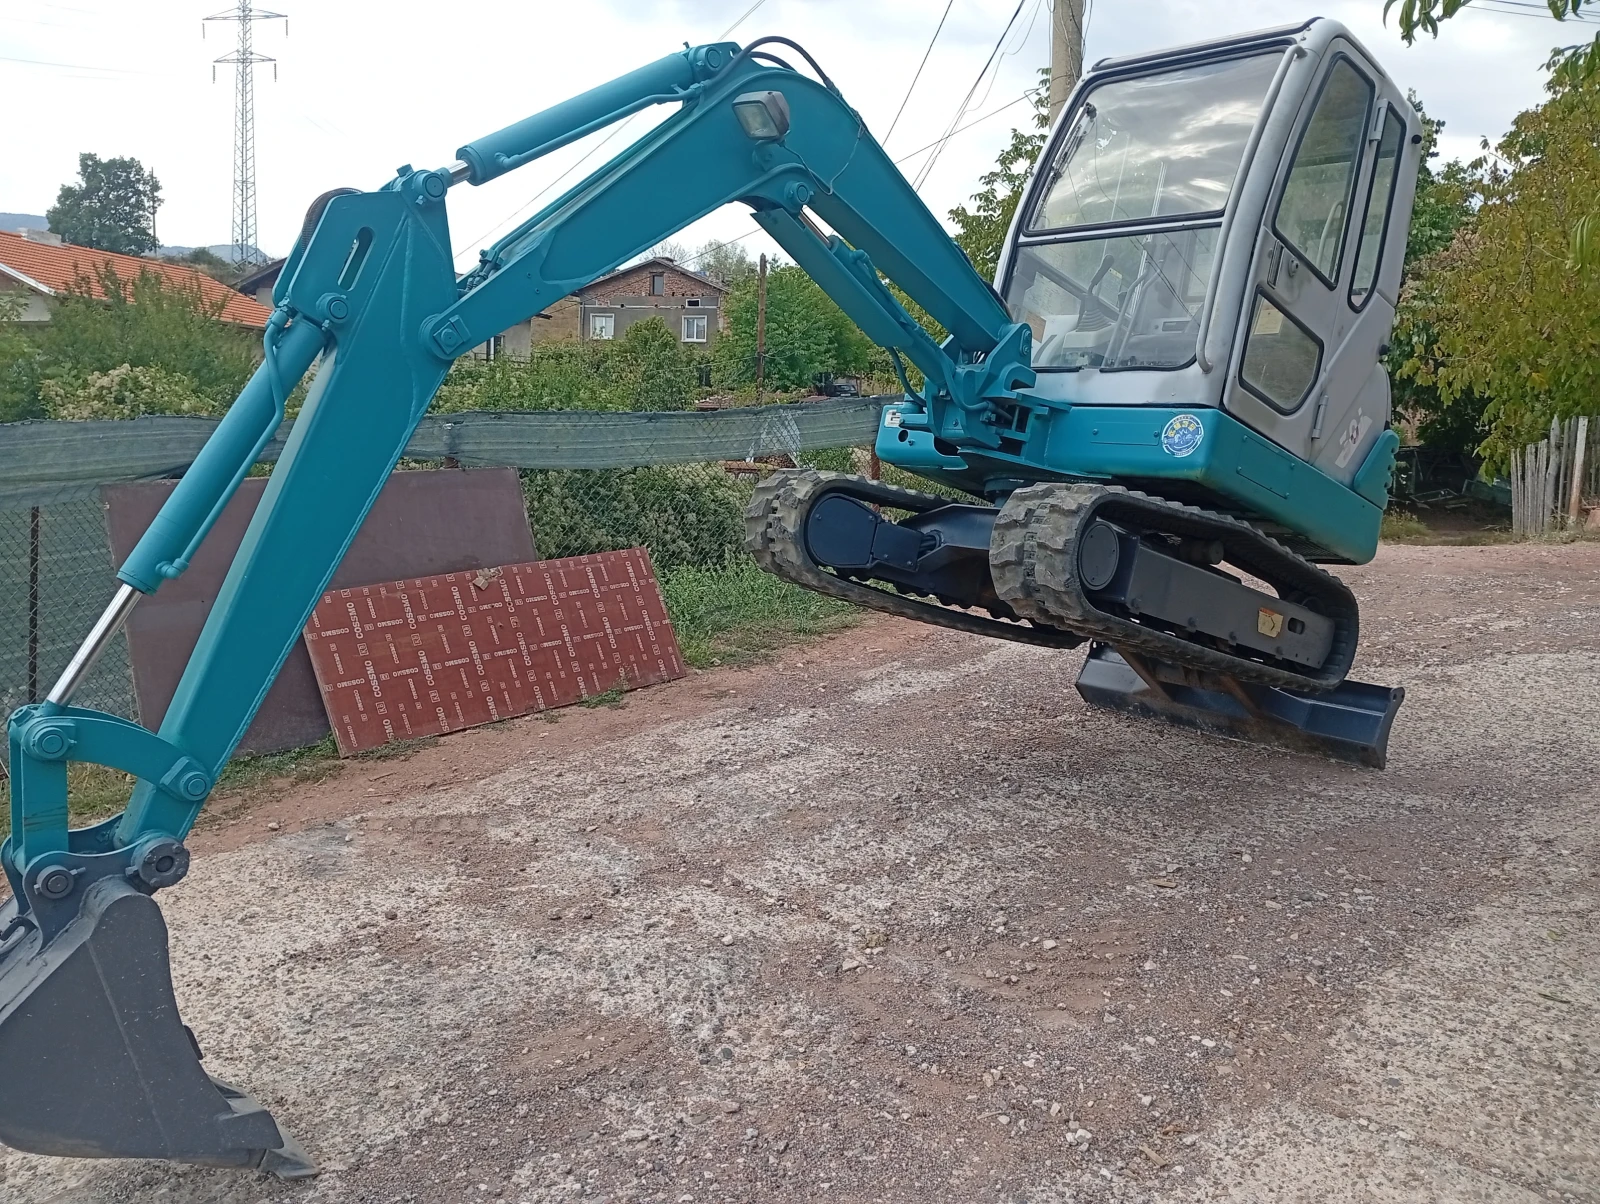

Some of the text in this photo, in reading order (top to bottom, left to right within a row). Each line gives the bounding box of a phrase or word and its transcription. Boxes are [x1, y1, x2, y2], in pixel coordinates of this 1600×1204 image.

[544, 573, 559, 605] COSSMO
[586, 567, 601, 598] COSSMO
[626, 562, 640, 592] COSSMO
[401, 594, 417, 630] COSSMO
[451, 586, 467, 621] COSSMO
[499, 579, 515, 613] COSSMO
[346, 602, 364, 639] COSSMO
[602, 617, 617, 649] COSSMO
[642, 610, 656, 641] COSSMO
[516, 632, 532, 666] COSSMO
[561, 624, 576, 657] COSSMO
[418, 650, 435, 686] COSSMO
[468, 641, 485, 676] COSSMO
[365, 661, 382, 697] COSSMO
